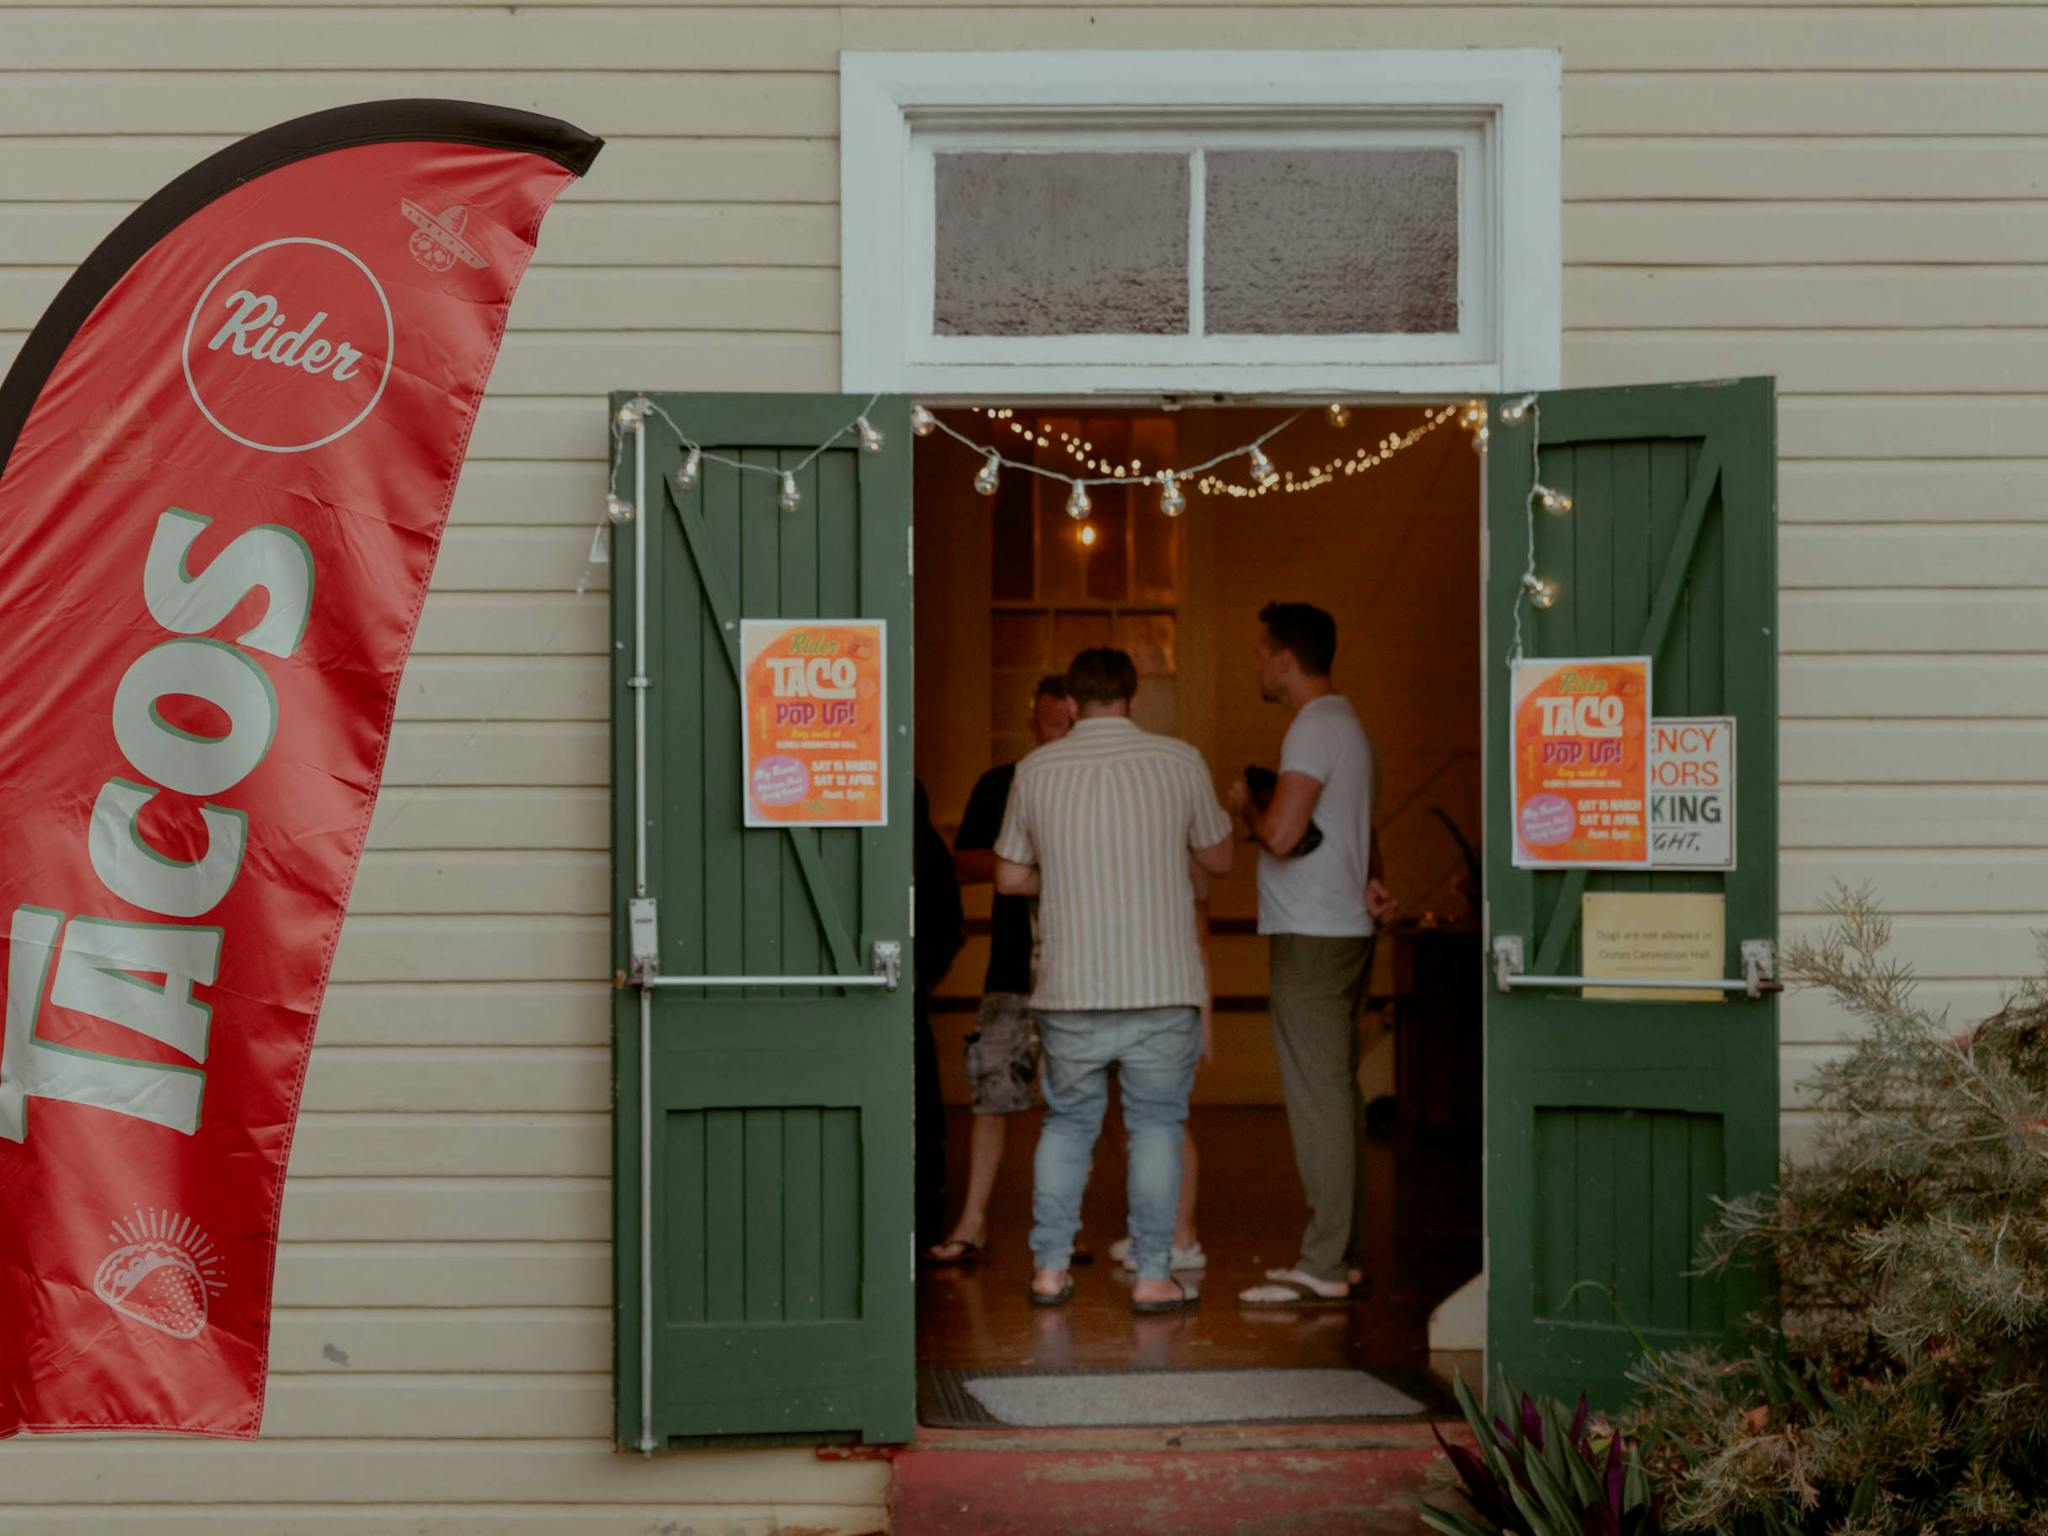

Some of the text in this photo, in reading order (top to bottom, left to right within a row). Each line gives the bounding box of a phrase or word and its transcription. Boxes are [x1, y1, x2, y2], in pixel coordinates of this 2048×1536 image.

[207, 290, 361, 382] Rider
[789, 633, 838, 655] Rider
[766, 657, 857, 699] TACO
[1559, 672, 1607, 693] Rider
[776, 701, 856, 726] POP UP!
[1536, 696, 1624, 737] TACO
[1543, 740, 1622, 764] POP UP!
[0, 506, 315, 1143] TACOS
[1642, 931, 1658, 940] not
[1661, 930, 1700, 940] allowed
